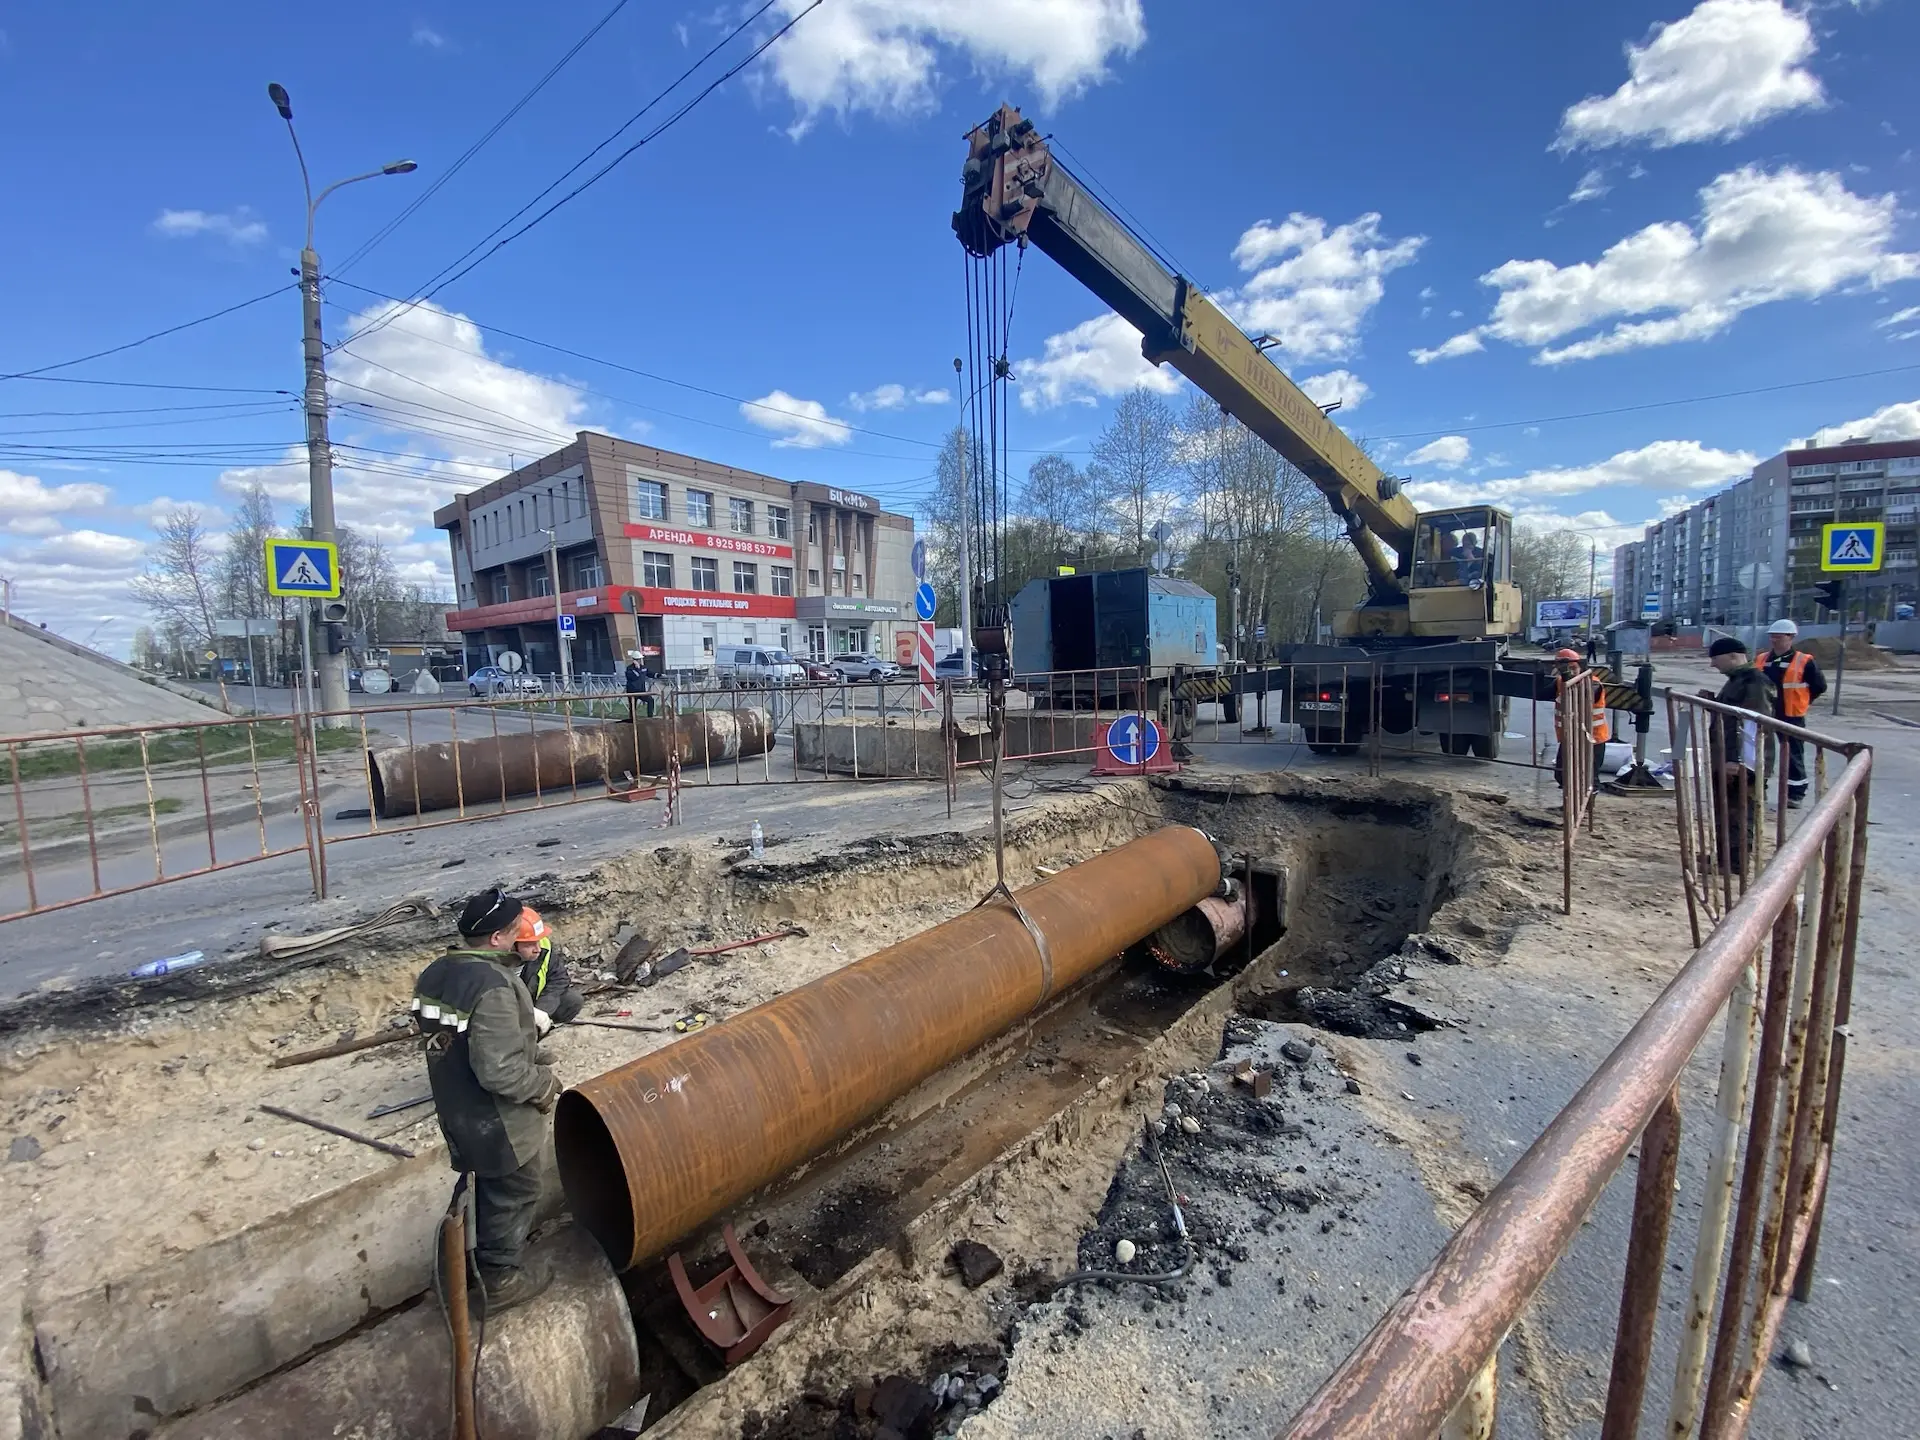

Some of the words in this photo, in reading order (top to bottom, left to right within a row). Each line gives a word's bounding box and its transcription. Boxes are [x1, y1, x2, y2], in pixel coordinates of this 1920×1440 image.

[830, 489, 843, 505] БЦ
[649, 528, 694, 544] АРЕНДА
[707, 536, 714, 547] 8
[716, 538, 734, 549] 925
[735, 542, 753, 553] 998
[754, 545, 765, 554] 53
[767, 546, 776, 555] 77
[663, 596, 697, 607] ГОРОДСКОЕ
[698, 598, 733, 609] РИТУАЛЬНОЕ
[734, 600, 749, 609] БЮРО
[864, 605, 898, 614] АВТОЗАПЧАСТИ
